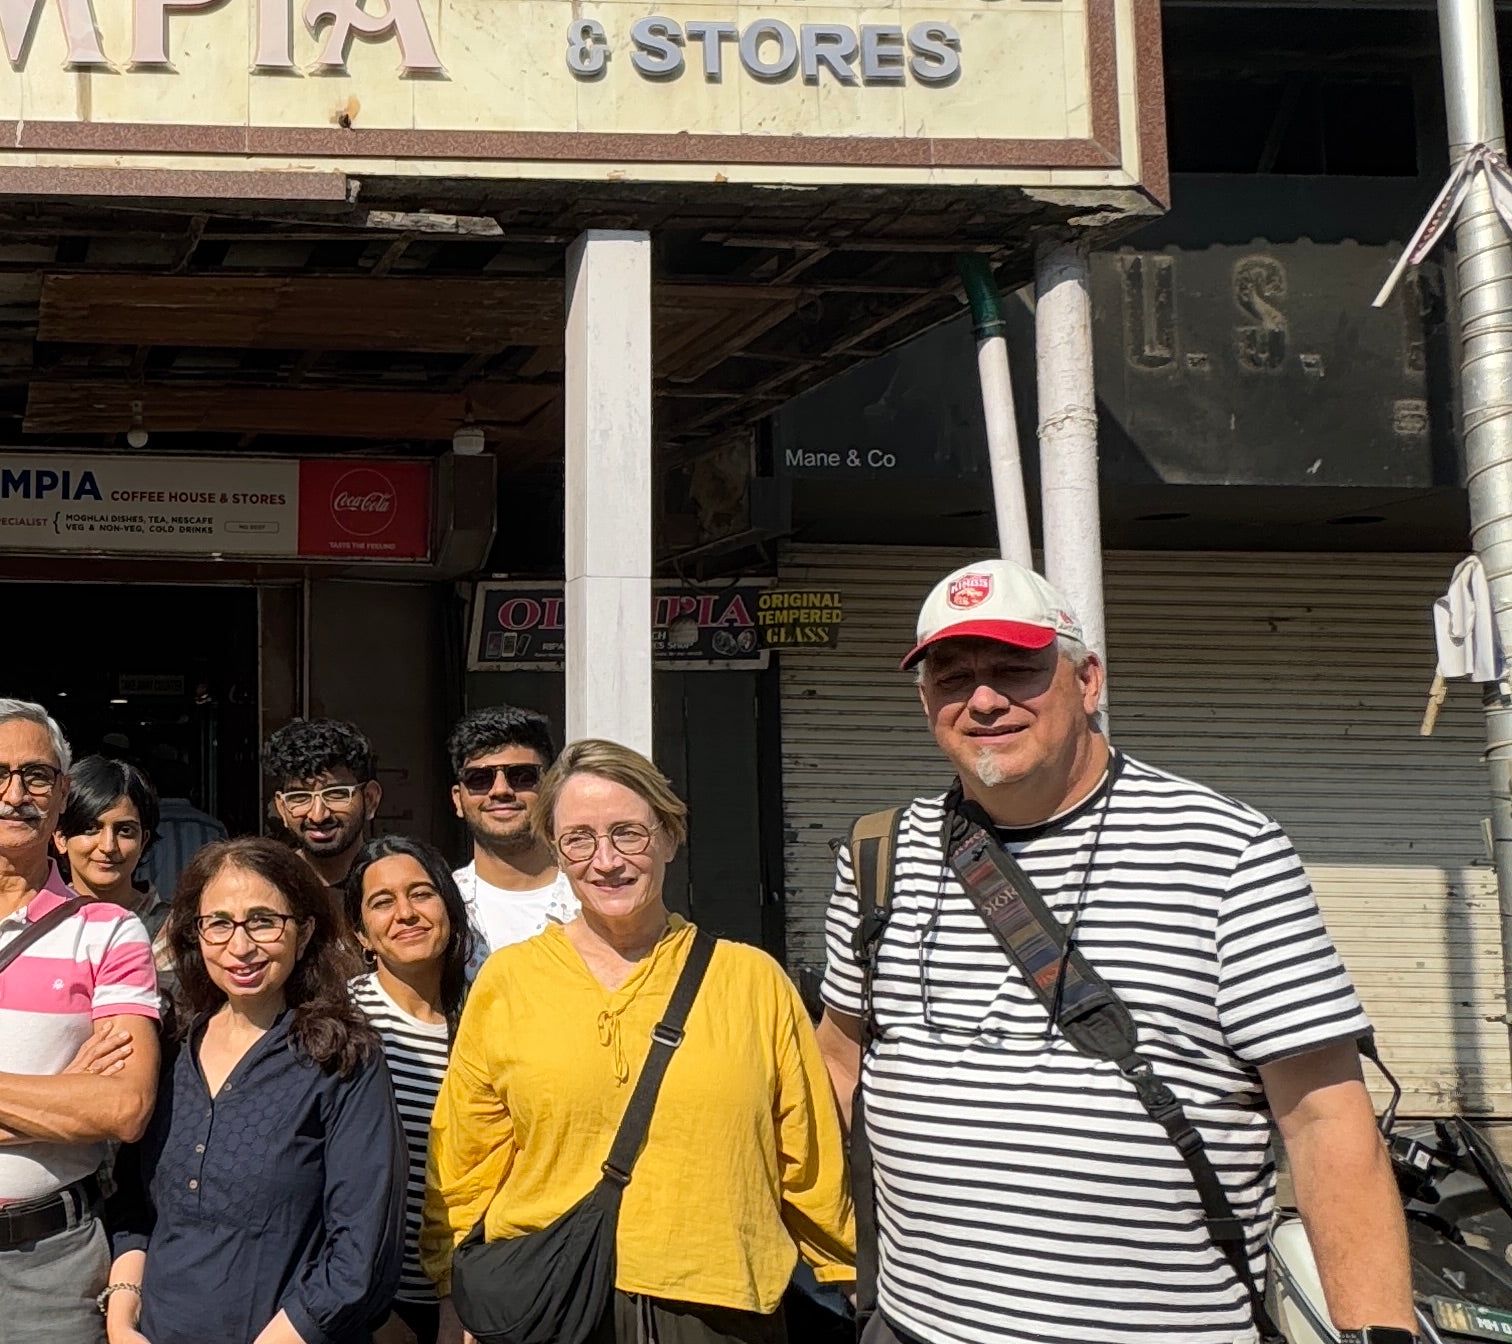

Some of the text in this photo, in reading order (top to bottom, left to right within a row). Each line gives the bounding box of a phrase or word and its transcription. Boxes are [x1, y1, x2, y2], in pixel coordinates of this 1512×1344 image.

[566, 16, 962, 86] & STORES
[786, 448, 896, 469] Mane & Co
[111, 491, 286, 505] COFFEE HOUSE & STORES
[111, 515, 147, 524] DISHES,
[148, 516, 169, 524] TEA,
[171, 516, 214, 525] NESCAFE
[66, 523, 85, 532] VEG
[99, 524, 145, 534] NON-VEG,
[149, 525, 175, 534] COLD
[179, 525, 214, 535] DRINKS
[759, 592, 843, 609] ORIGINAL
[757, 609, 843, 625] TEMPERED
[766, 626, 830, 644] GLASS
[1476, 1317, 1500, 1332] MH
